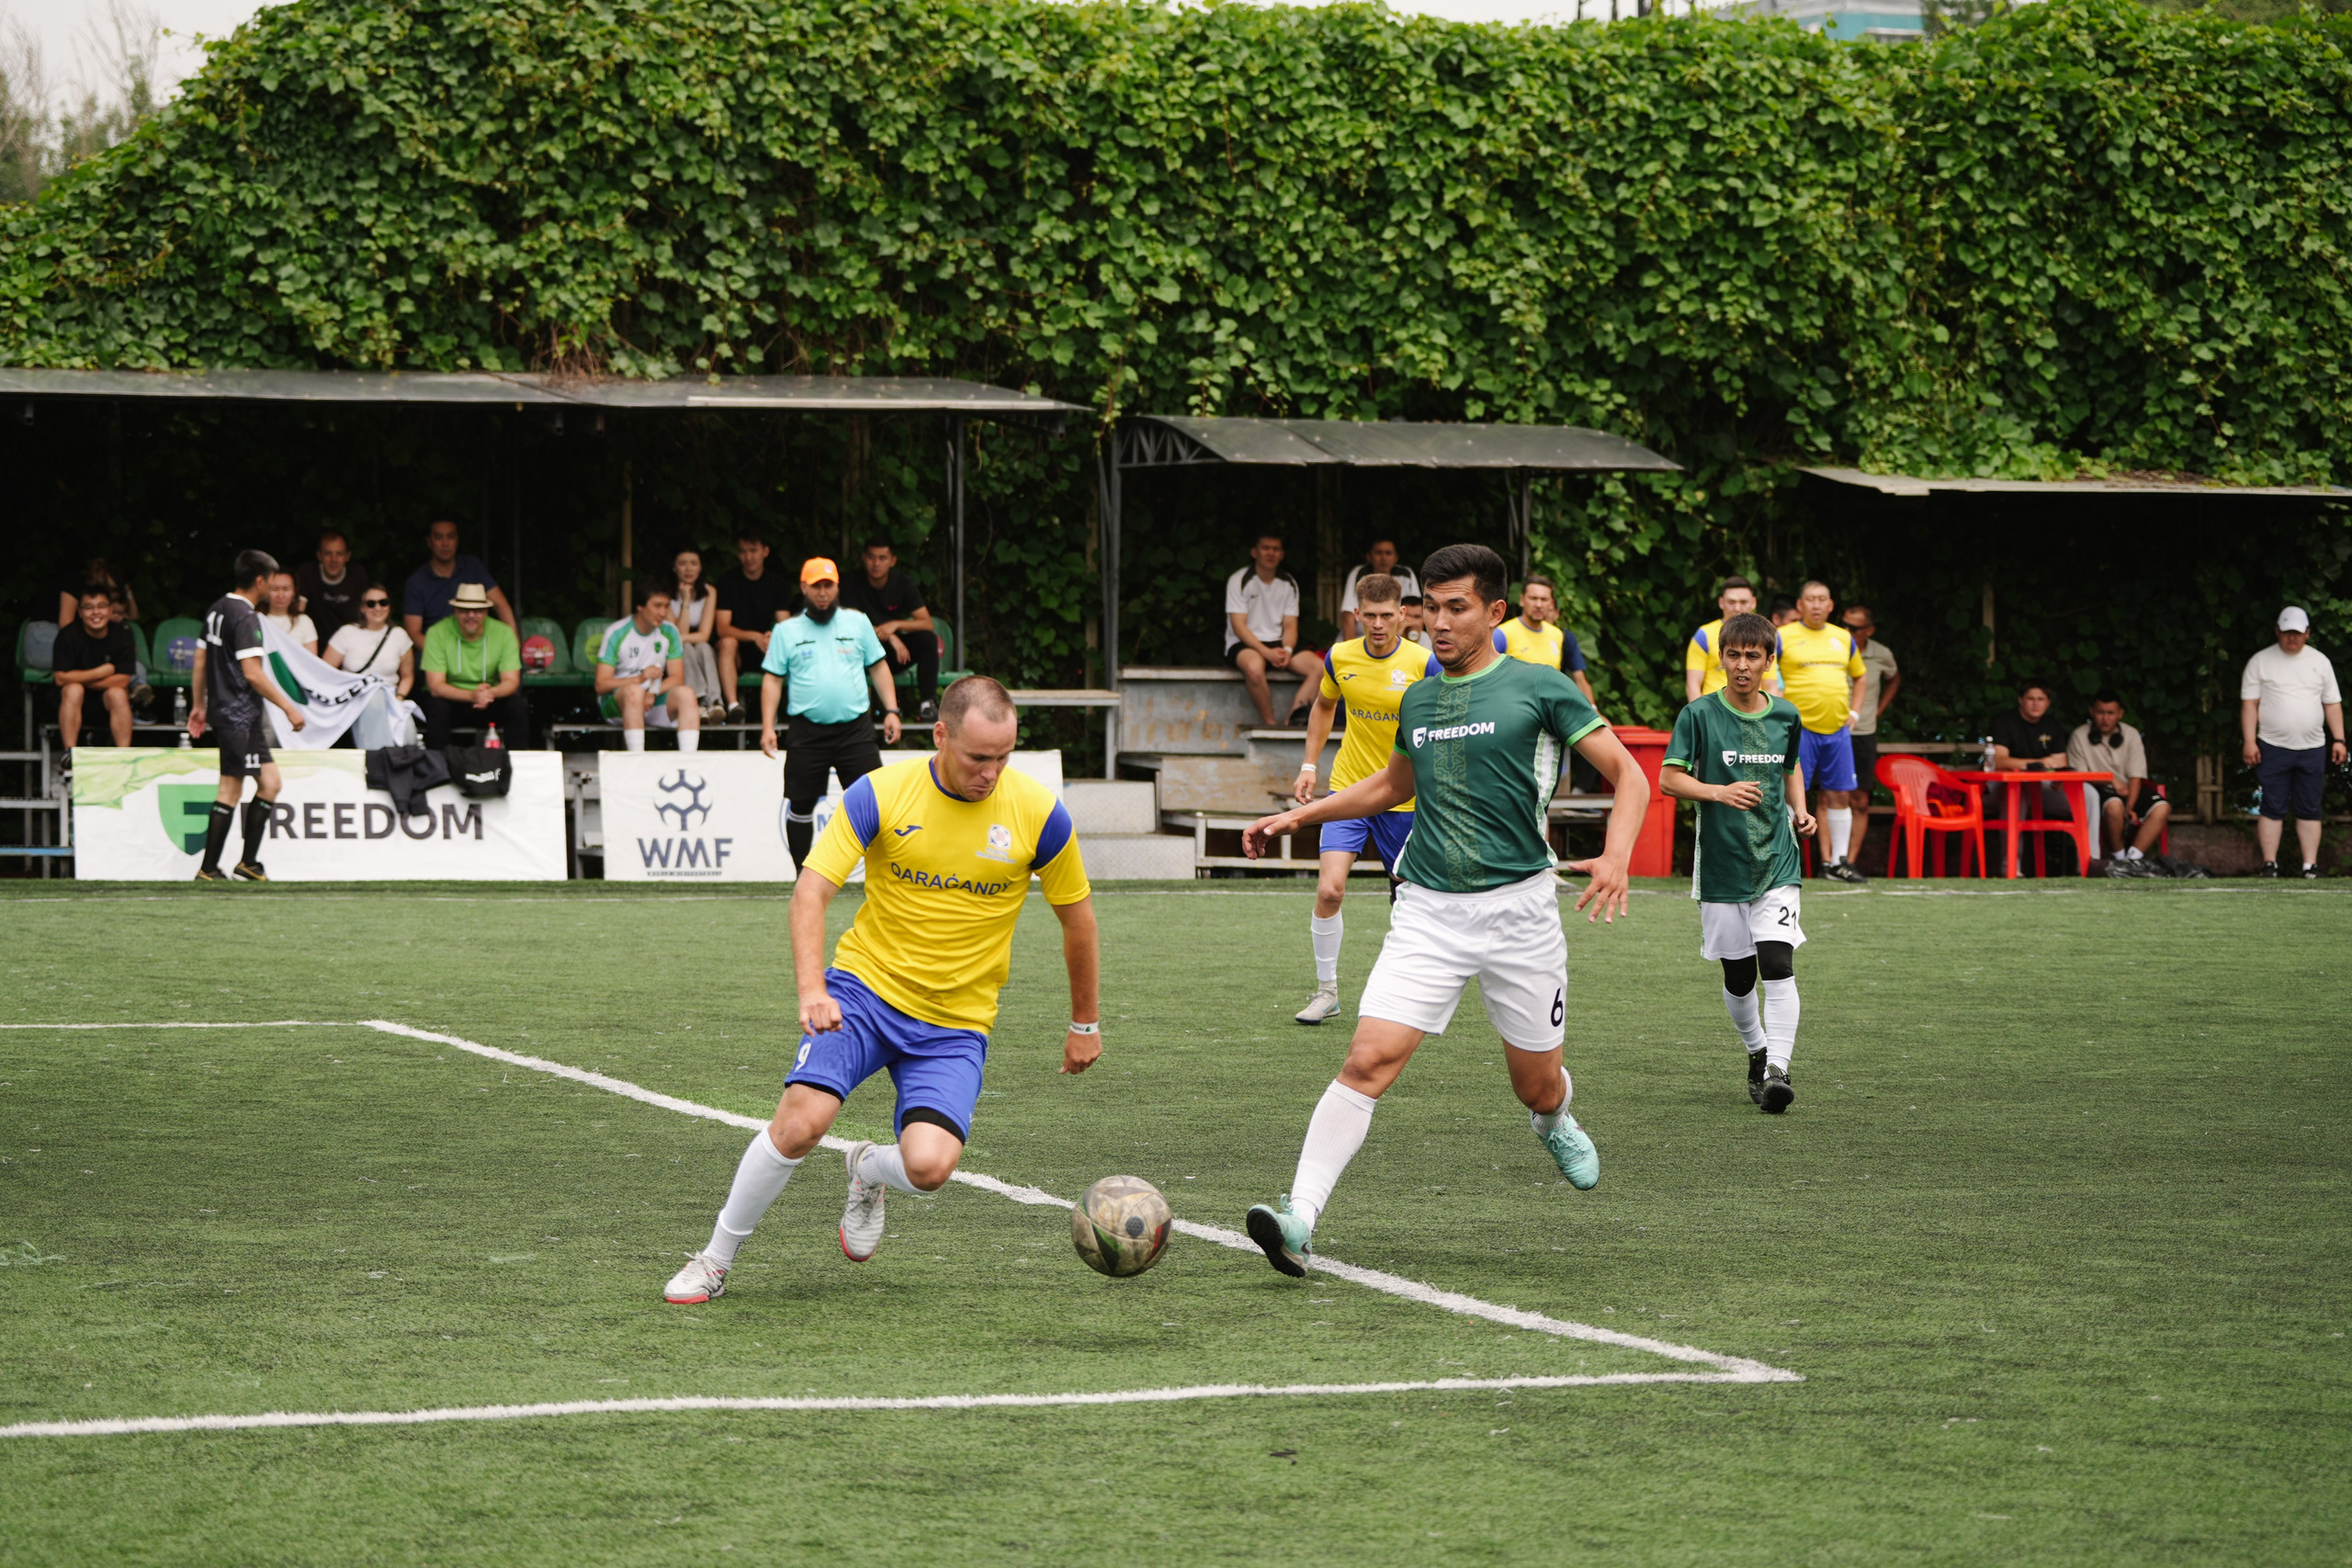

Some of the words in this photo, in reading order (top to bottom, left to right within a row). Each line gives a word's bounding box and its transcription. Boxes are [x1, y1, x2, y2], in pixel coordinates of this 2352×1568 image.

[206, 611, 224, 647] 11
[1428, 722, 1495, 741] FREEDOM
[244, 753, 262, 769] 11
[637, 838, 733, 868] WMF
[1778, 906, 1796, 930] 21
[1551, 987, 1563, 1027] 6
[795, 1043, 811, 1071] 9
